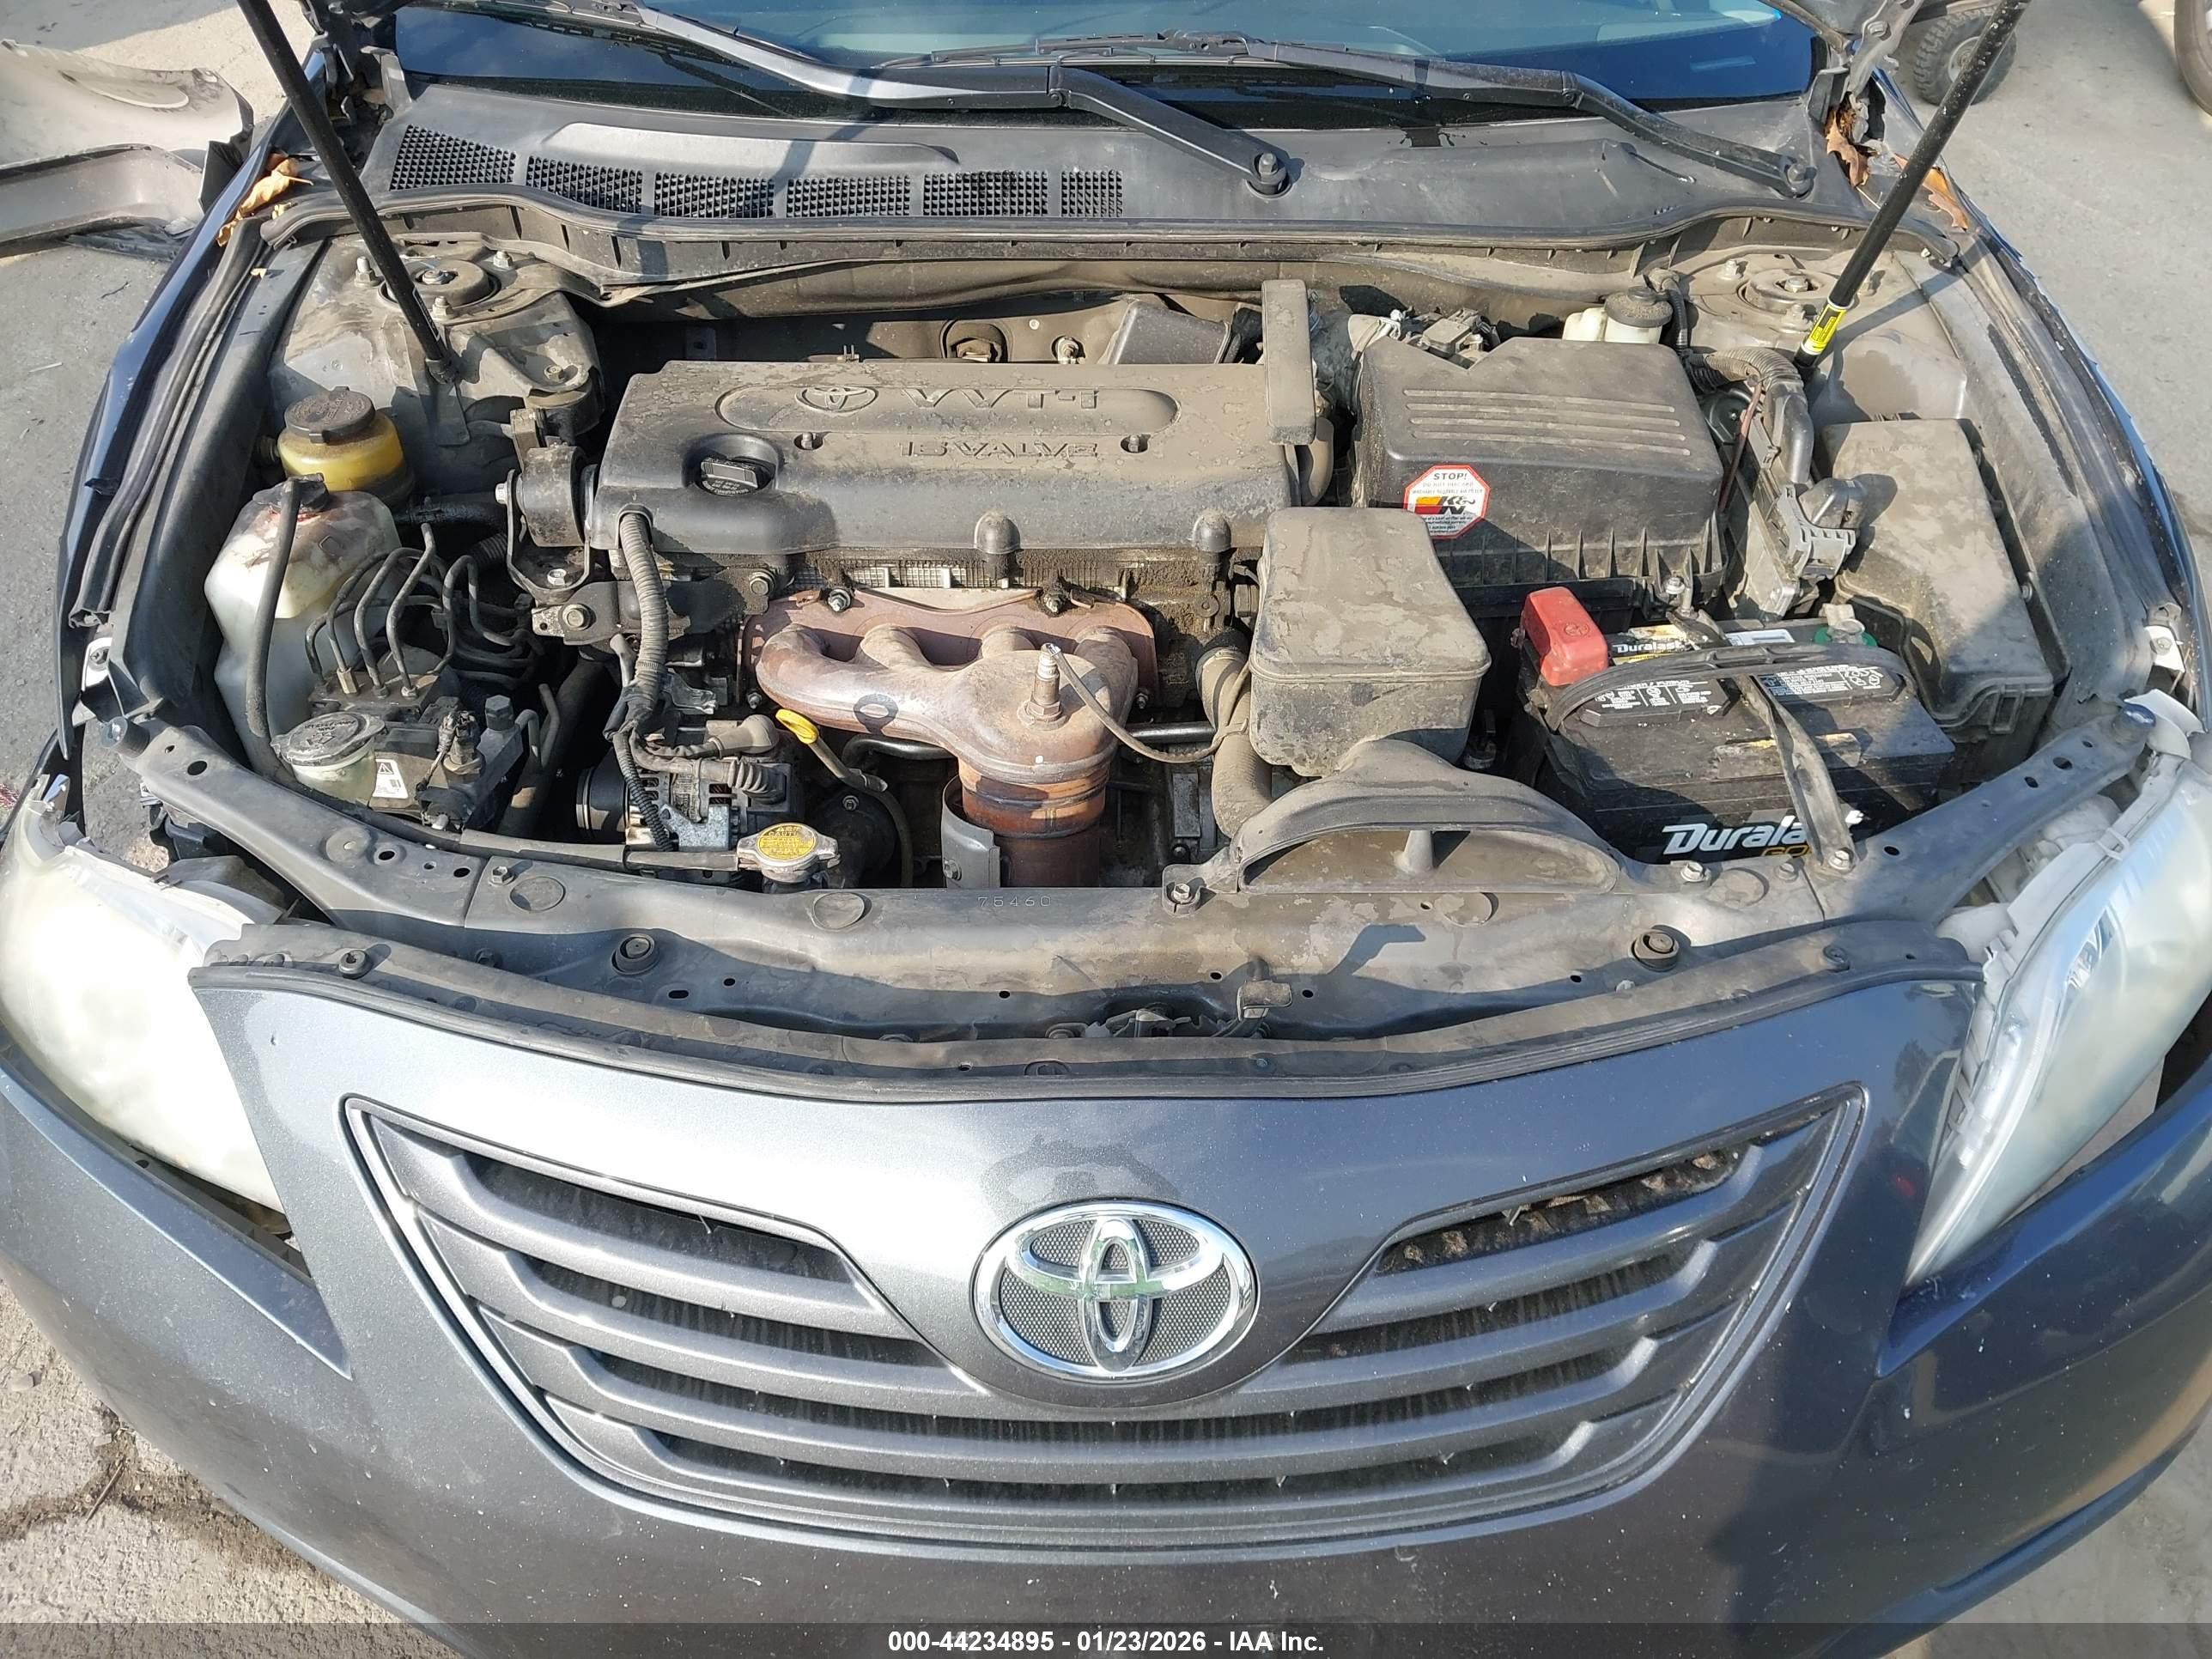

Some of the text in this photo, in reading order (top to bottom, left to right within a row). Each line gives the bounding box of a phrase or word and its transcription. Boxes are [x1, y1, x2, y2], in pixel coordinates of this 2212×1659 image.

[954, 441, 1099, 458] VALVE
[1433, 472, 1468, 481] STOP!
[1613, 641, 1685, 653] Duralast
[977, 896, 1052, 908] 75460
